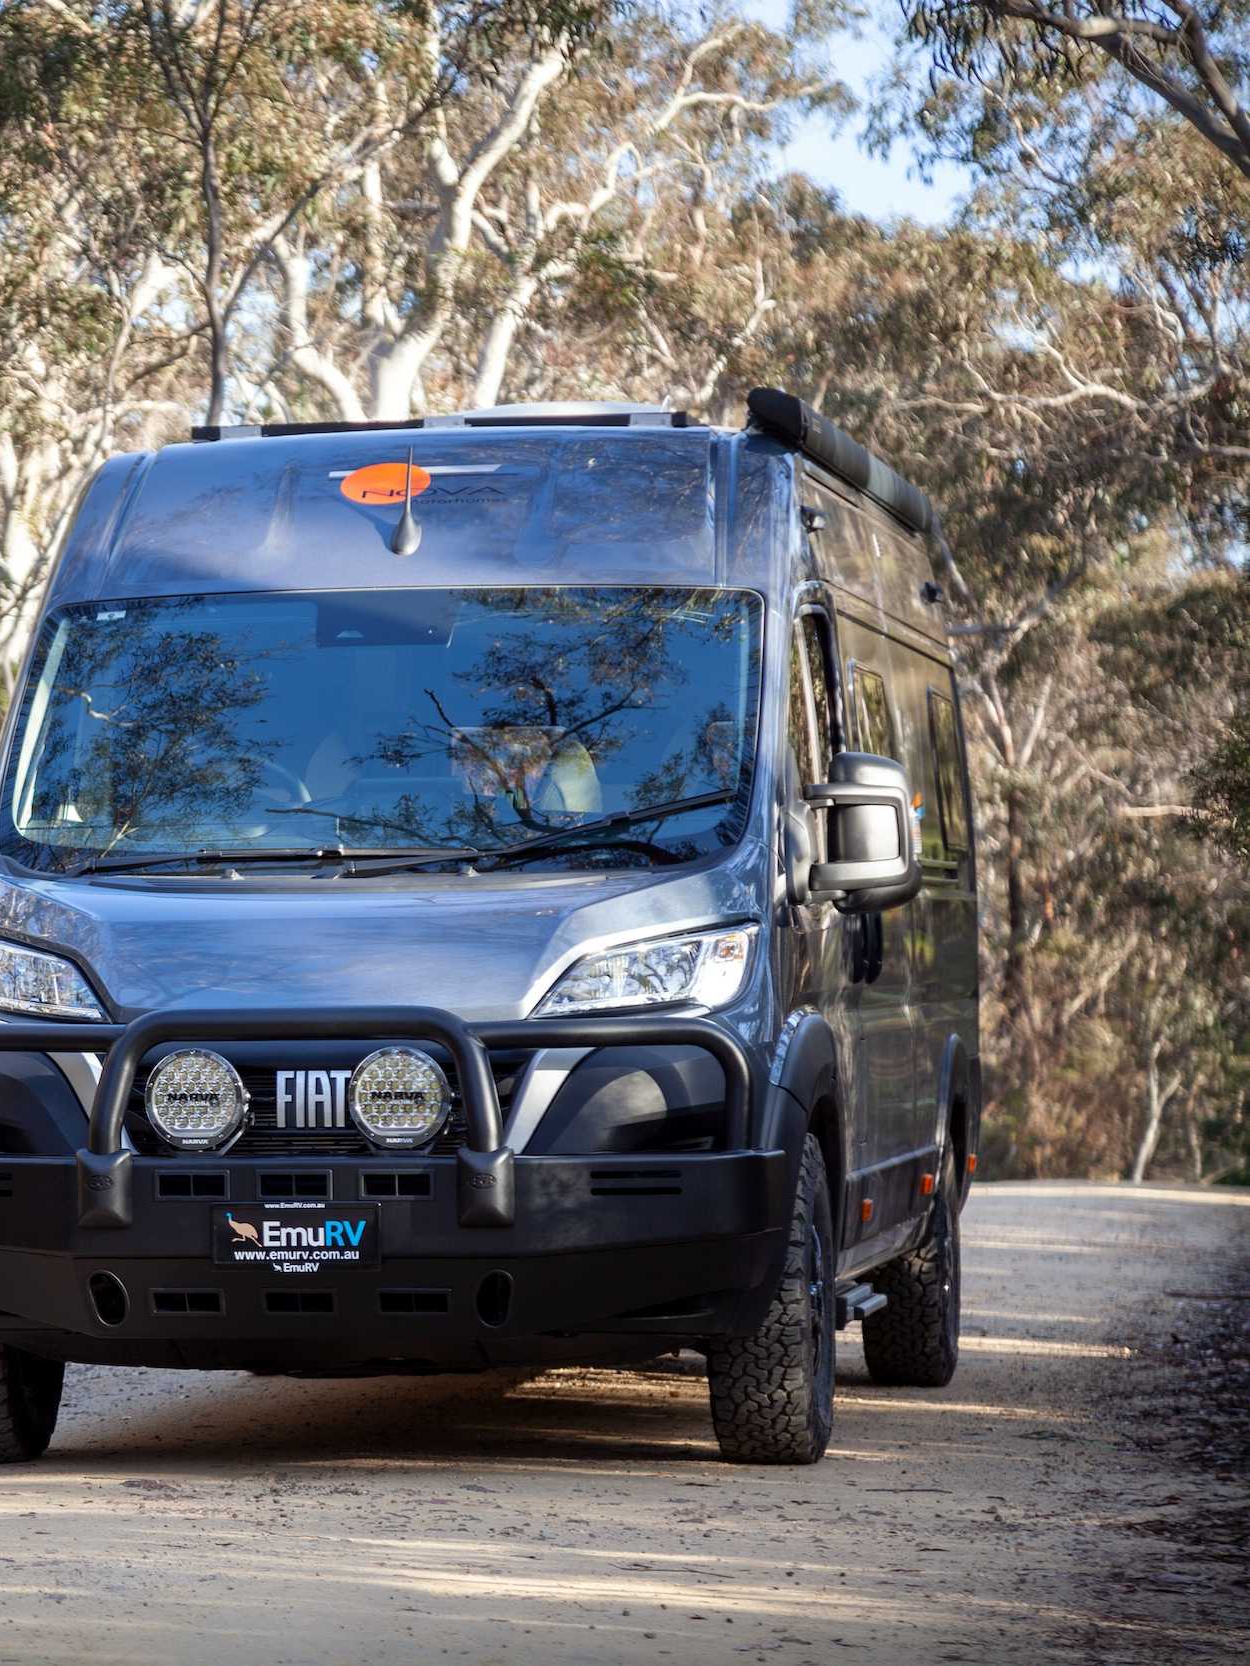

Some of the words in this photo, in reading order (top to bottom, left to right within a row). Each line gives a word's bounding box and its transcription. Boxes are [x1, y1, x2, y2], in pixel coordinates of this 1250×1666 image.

[276, 1070, 352, 1128] FIAT
[262, 1220, 367, 1248] EmuRV
[233, 1250, 361, 1261] www.emurv.com.au
[282, 1262, 320, 1273] EmuRV
